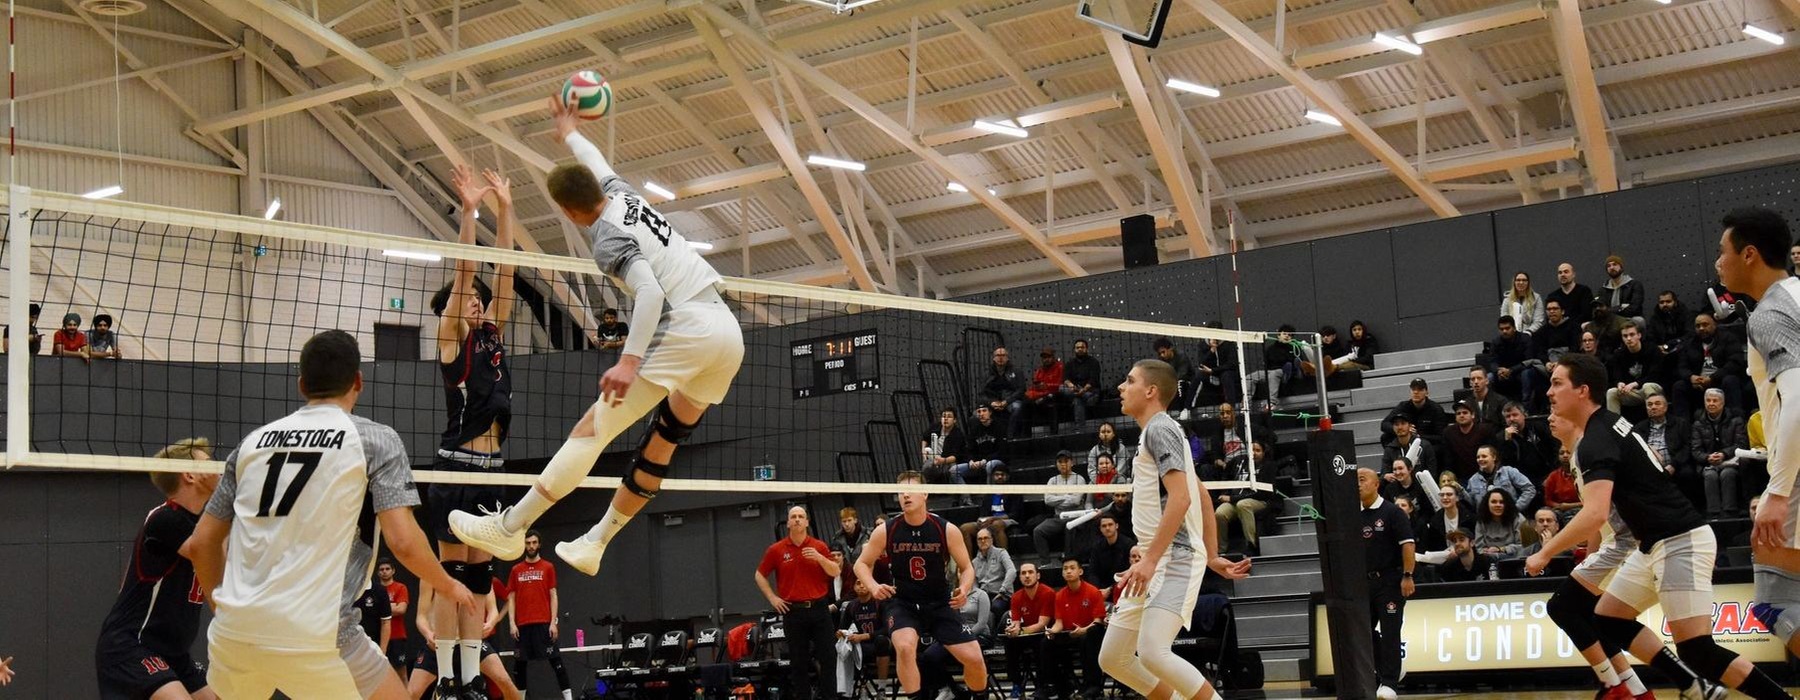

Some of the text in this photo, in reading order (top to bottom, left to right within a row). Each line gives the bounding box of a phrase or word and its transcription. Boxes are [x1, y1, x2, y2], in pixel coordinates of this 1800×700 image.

[792, 344, 813, 357] HOME
[854, 334, 877, 347] GUEST
[256, 429, 346, 450] CONESTOGA
[256, 451, 324, 517] 17
[892, 542, 941, 553] LOYALIST
[909, 556, 927, 581] 6
[1455, 602, 1525, 623] HOME
[1437, 623, 1574, 663] CONDO
[141, 656, 170, 676] 10
